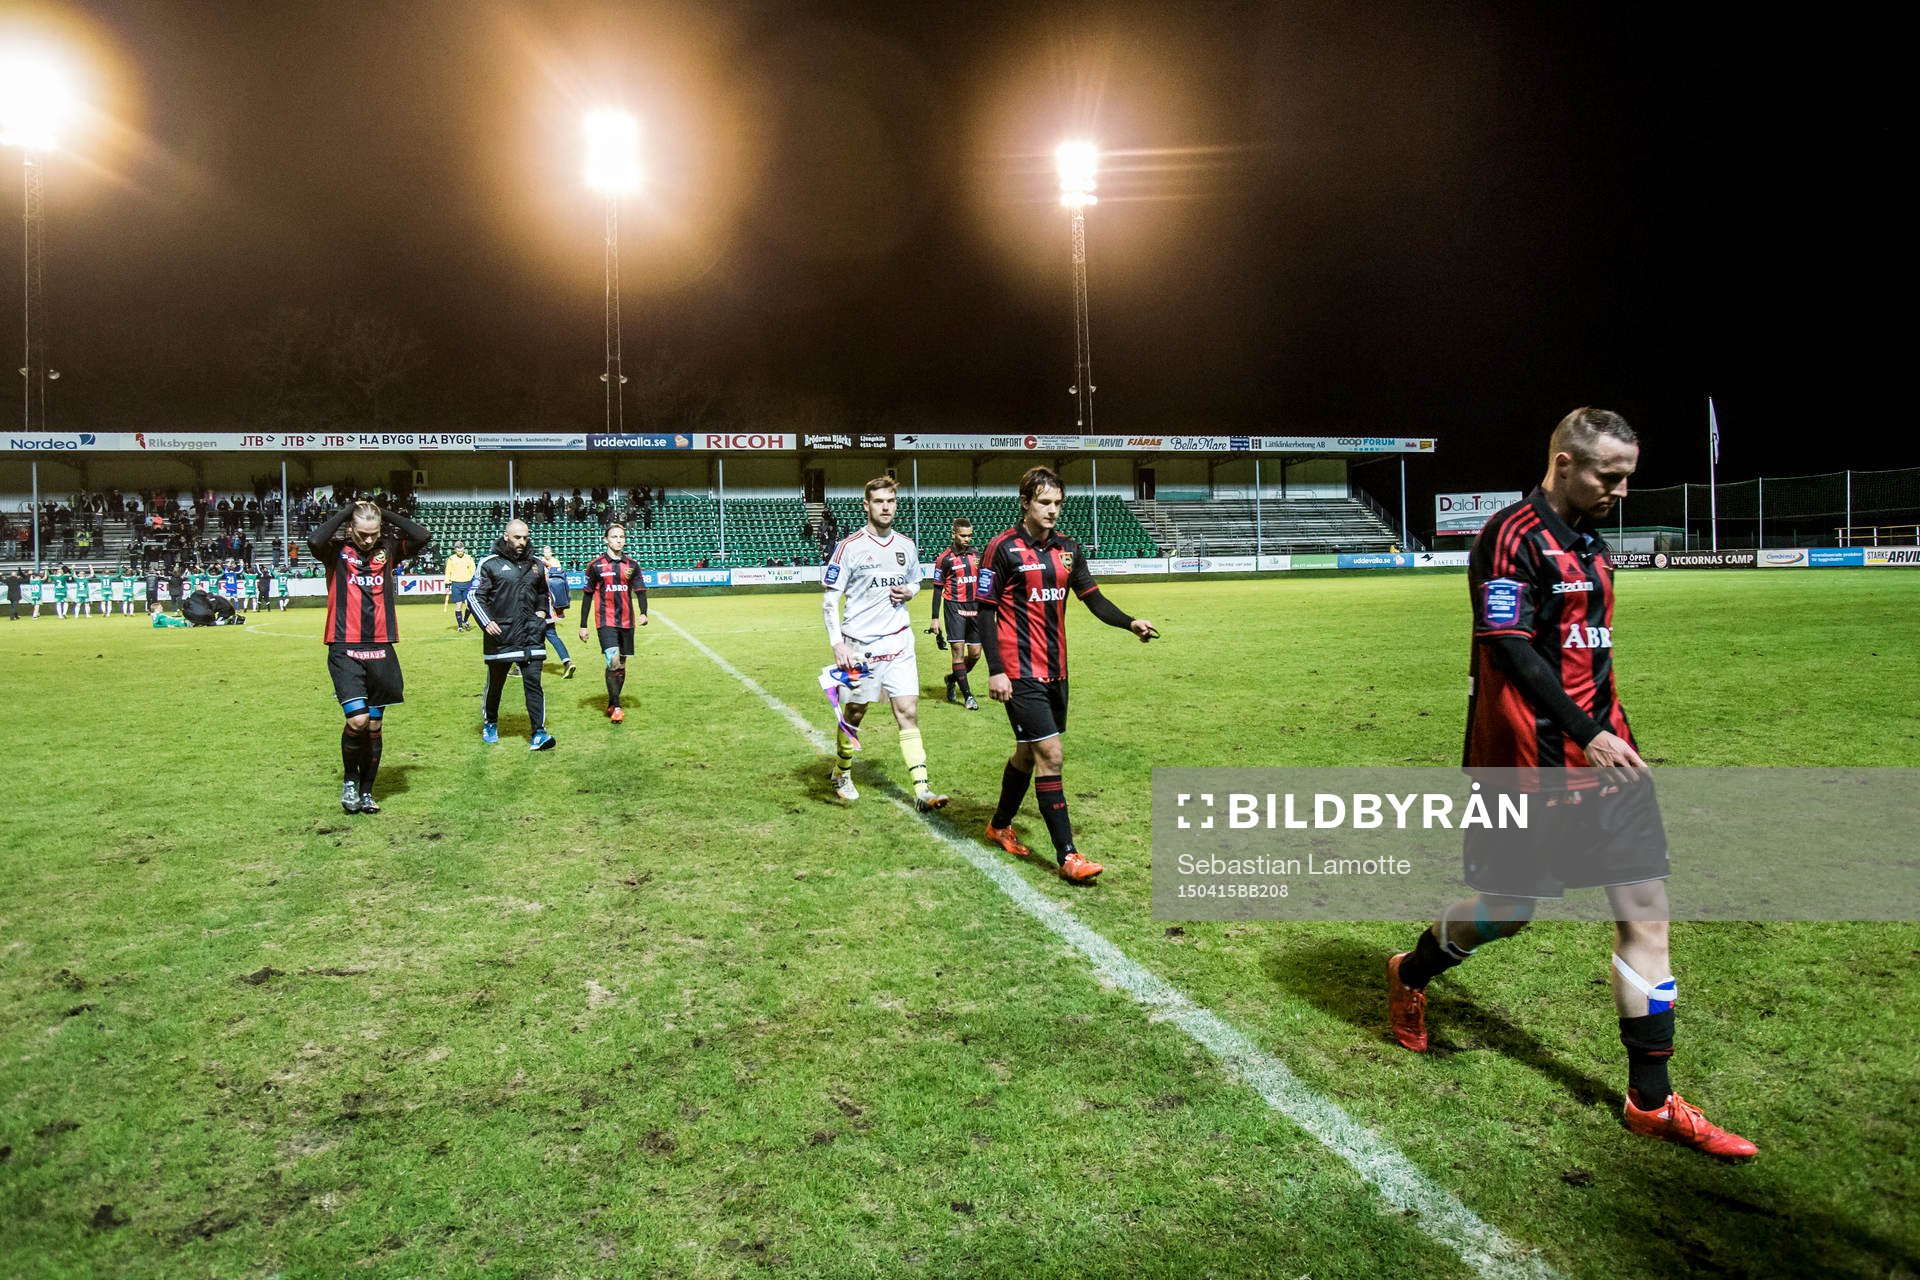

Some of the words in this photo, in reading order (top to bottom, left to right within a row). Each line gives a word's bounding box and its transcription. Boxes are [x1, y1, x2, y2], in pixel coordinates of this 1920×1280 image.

[10, 439, 77, 449] Nordea
[149, 438, 217, 449] Riksbyggen
[240, 436, 264, 446] JTB
[281, 436, 304, 446] JTB
[321, 436, 344, 446] JTB
[359, 435, 379, 445] H.A
[382, 435, 414, 445] BYGG
[418, 435, 438, 445] H.A
[441, 435, 472, 445] BYGG
[594, 436, 667, 447] uddevalla.se
[706, 435, 784, 448] RICOH
[990, 437, 1022, 447] COMFORT
[1098, 438, 1124, 447] ARVID
[1170, 437, 1198, 450] Bella
[1199, 437, 1227, 450] Mare
[1337, 438, 1362, 447] coop
[1363, 438, 1395, 446] FORUM
[416, 471, 425, 484] A
[1629, 553, 1650, 561] ÖPPET
[1671, 555, 1723, 566] LYCKORNAS
[1725, 554, 1754, 564] CAMP
[1866, 551, 1888, 560] STARKE
[1353, 557, 1391, 565] uddevalla.se
[227, 576, 235, 584] 21
[348, 573, 384, 586] ÅBRO
[671, 571, 729, 583] STRYKTIPSET
[1028, 587, 1066, 602] ÅBRO
[1562, 623, 1613, 648] ÅBR
